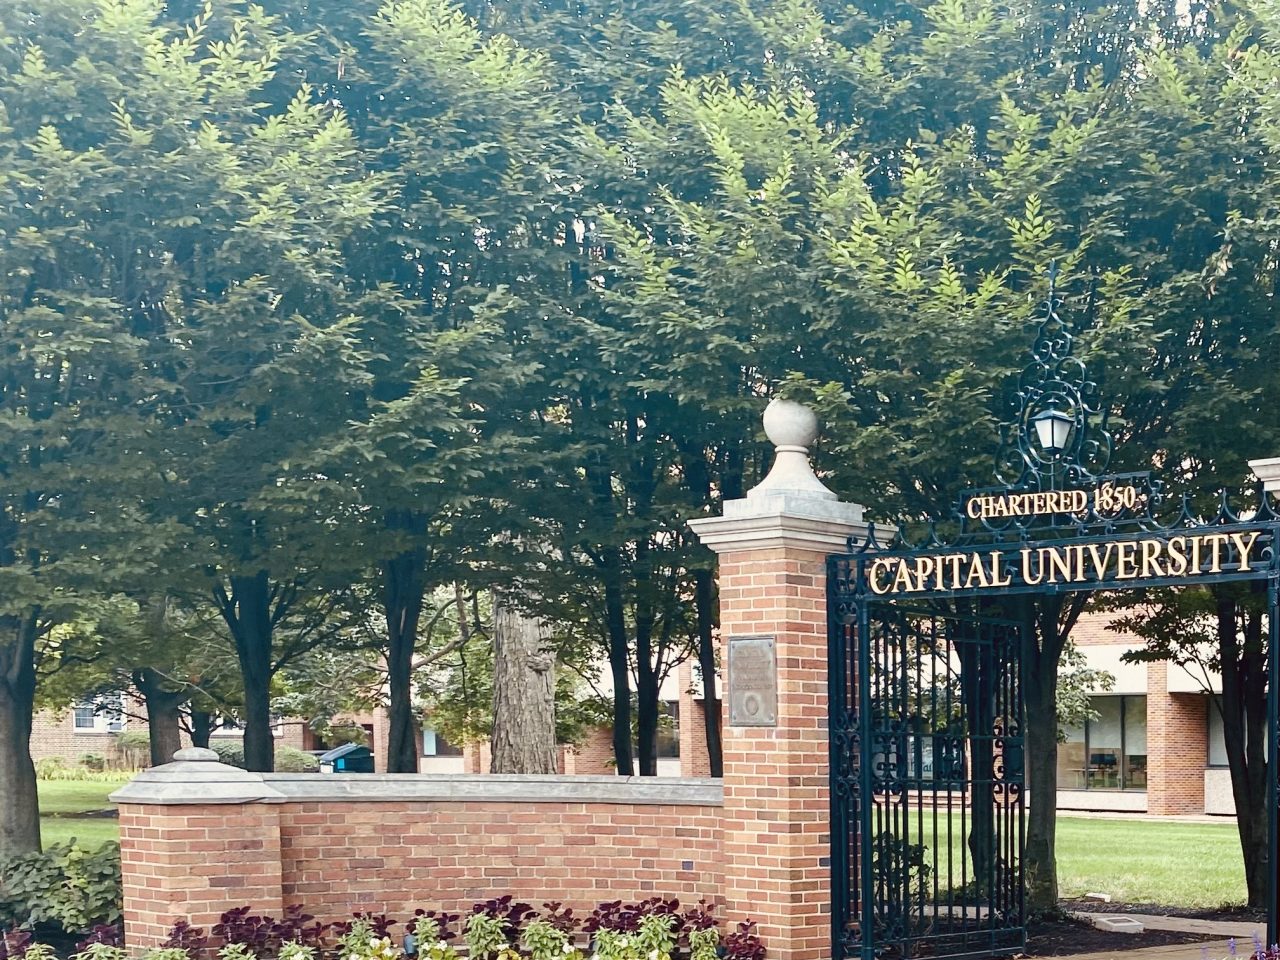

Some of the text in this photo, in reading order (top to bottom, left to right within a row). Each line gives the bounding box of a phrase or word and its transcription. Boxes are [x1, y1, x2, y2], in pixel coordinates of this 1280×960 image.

[967, 484, 1137, 519] CHARTERED 1850
[869, 532, 1261, 595] CAPITAL UNIVERSITY
